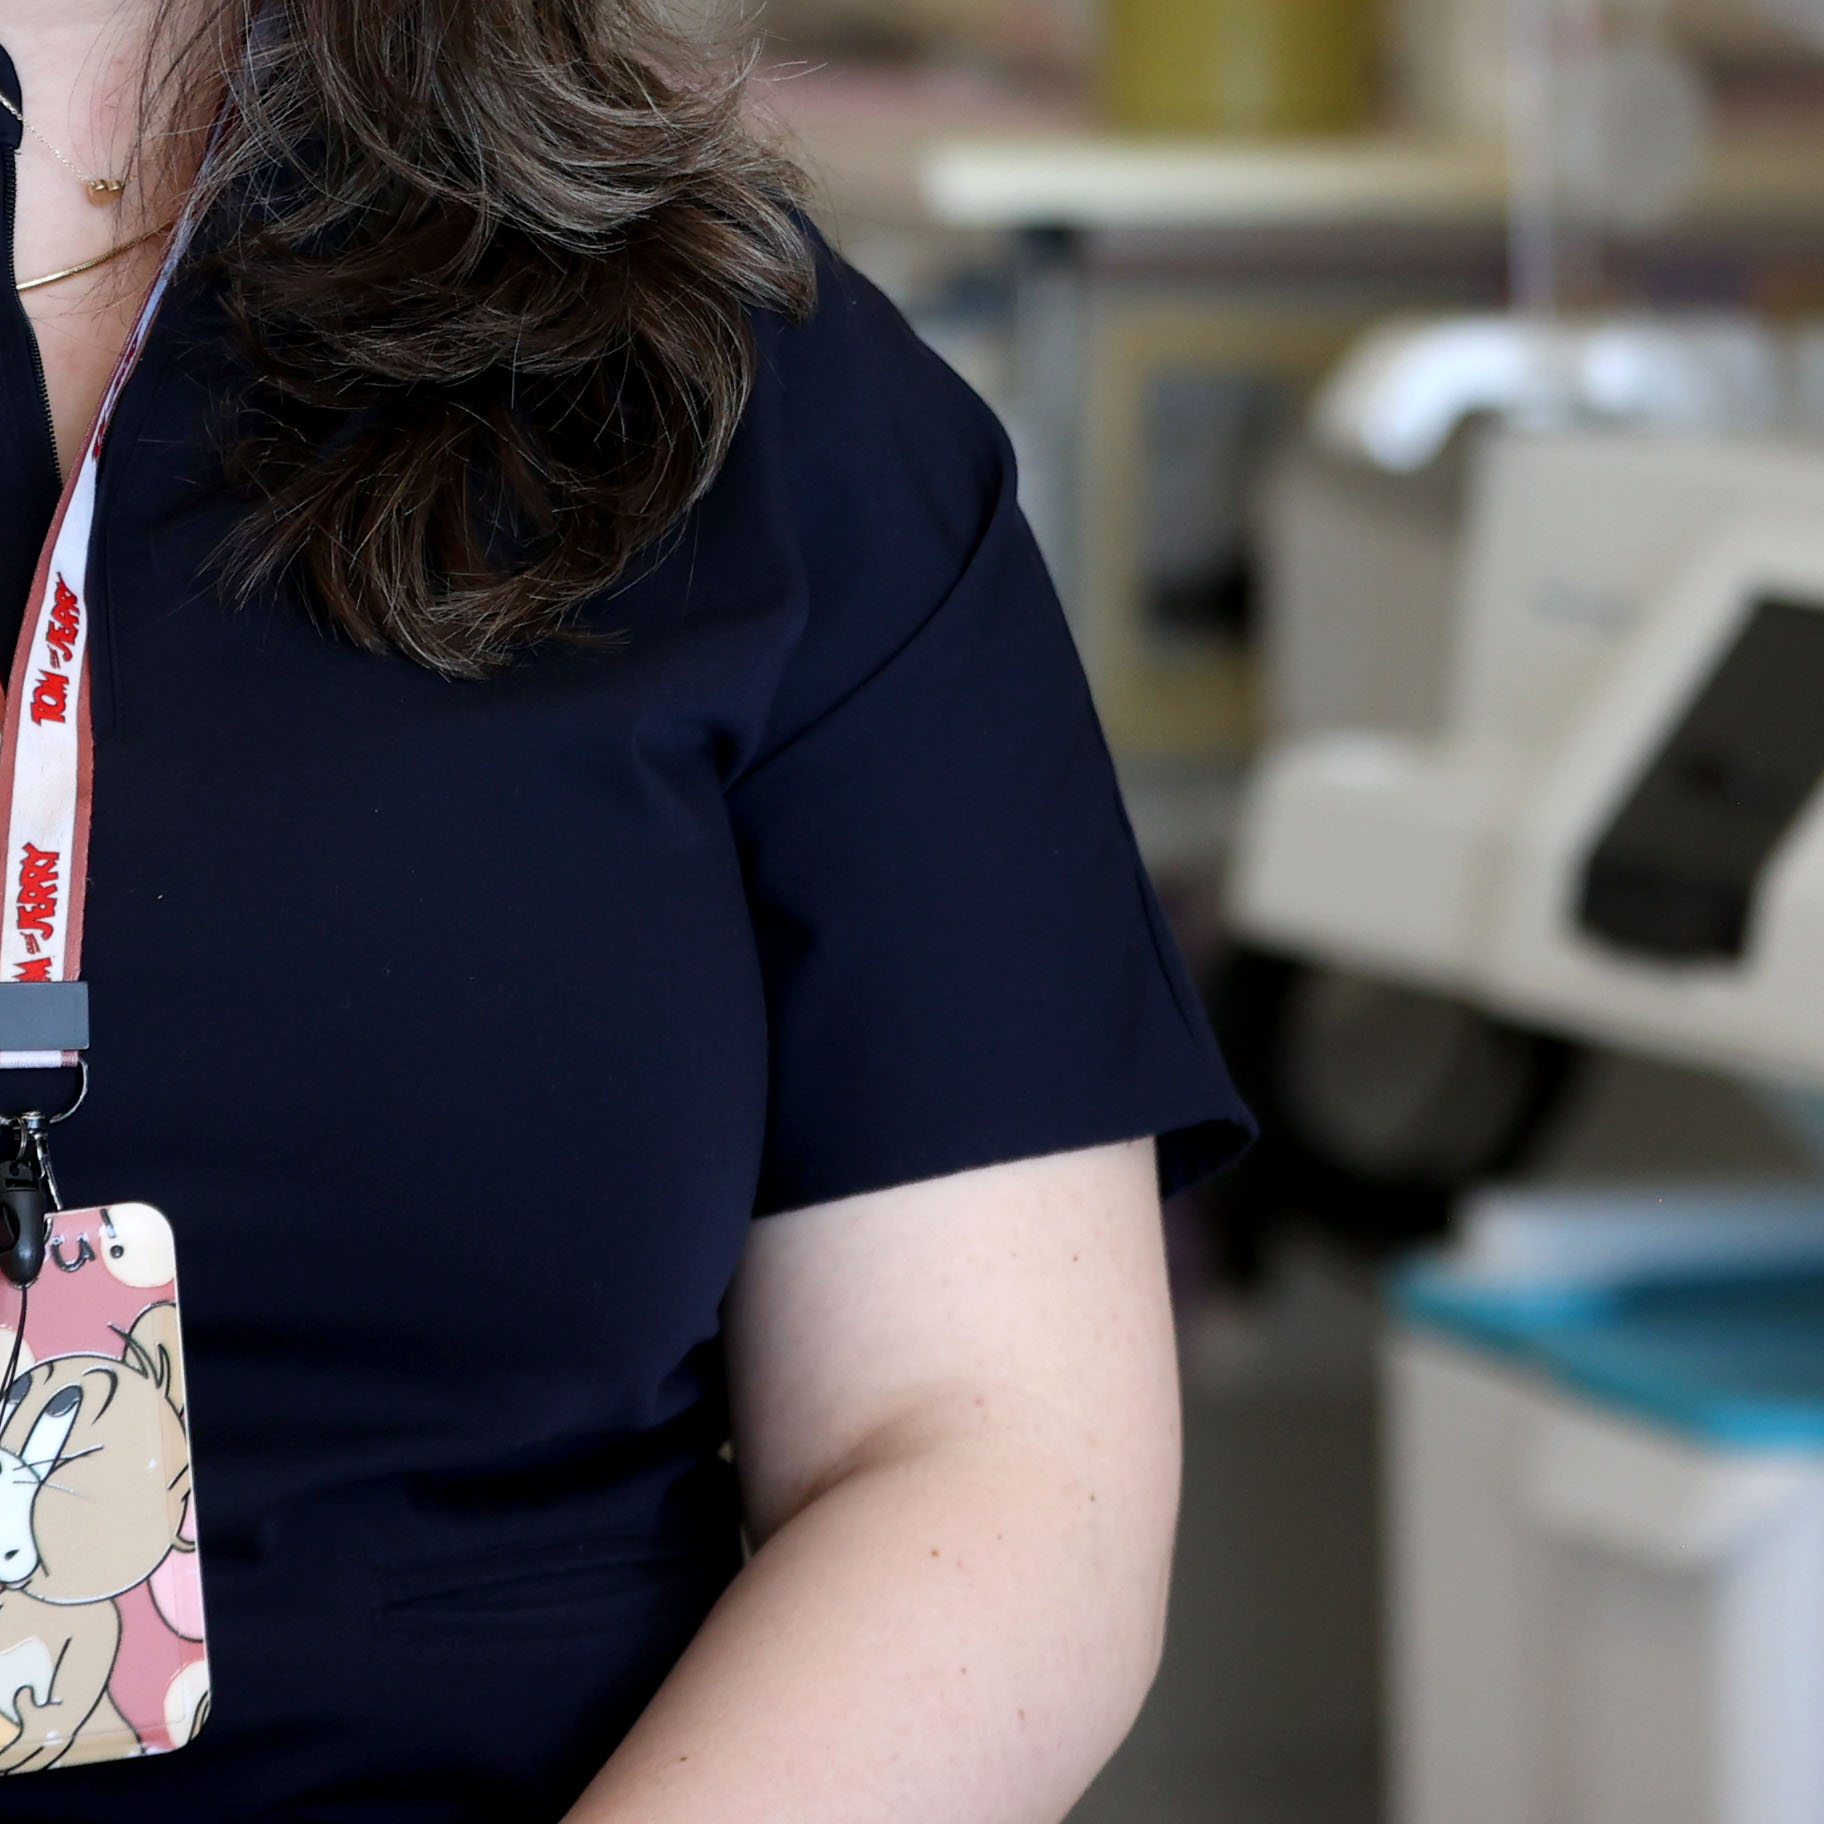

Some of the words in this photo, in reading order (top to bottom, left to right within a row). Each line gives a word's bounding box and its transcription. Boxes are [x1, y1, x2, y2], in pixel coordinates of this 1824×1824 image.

[46, 571, 80, 662] JERRY
[30, 669, 70, 726] TOM
[16, 842, 60, 940] JERRY
